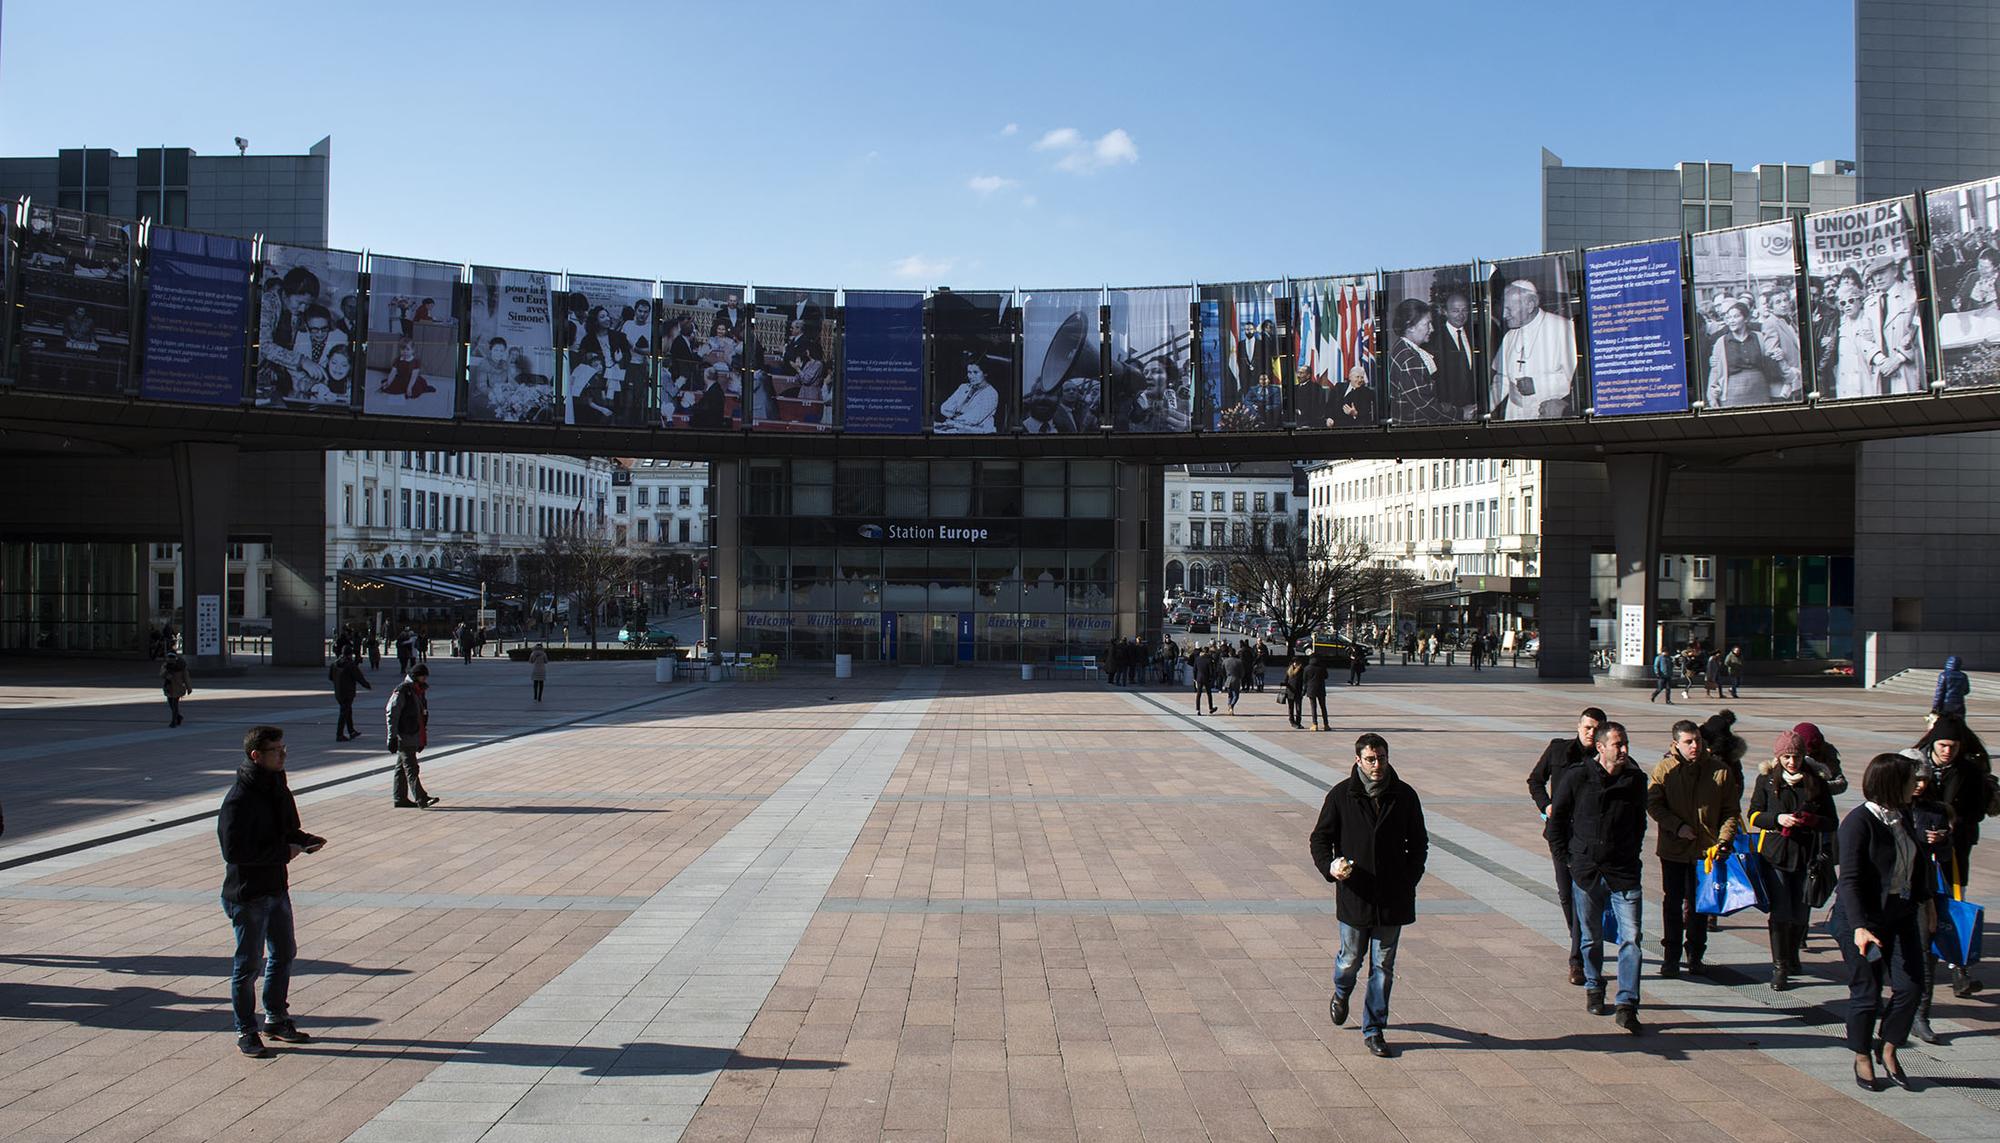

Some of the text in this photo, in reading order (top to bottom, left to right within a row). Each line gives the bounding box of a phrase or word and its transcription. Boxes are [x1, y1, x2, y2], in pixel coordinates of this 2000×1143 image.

[1814, 211, 1868, 232] UNION
[1818, 247, 1862, 264] JUIFS
[1867, 243, 1887, 257] de
[508, 312, 544, 323] Simone
[889, 525, 988, 542] Station Europe
[746, 615, 796, 626] Welcome
[807, 615, 876, 626] Willkommen
[988, 616, 1046, 627] Bienvenue
[1068, 616, 1112, 628] Welkom
